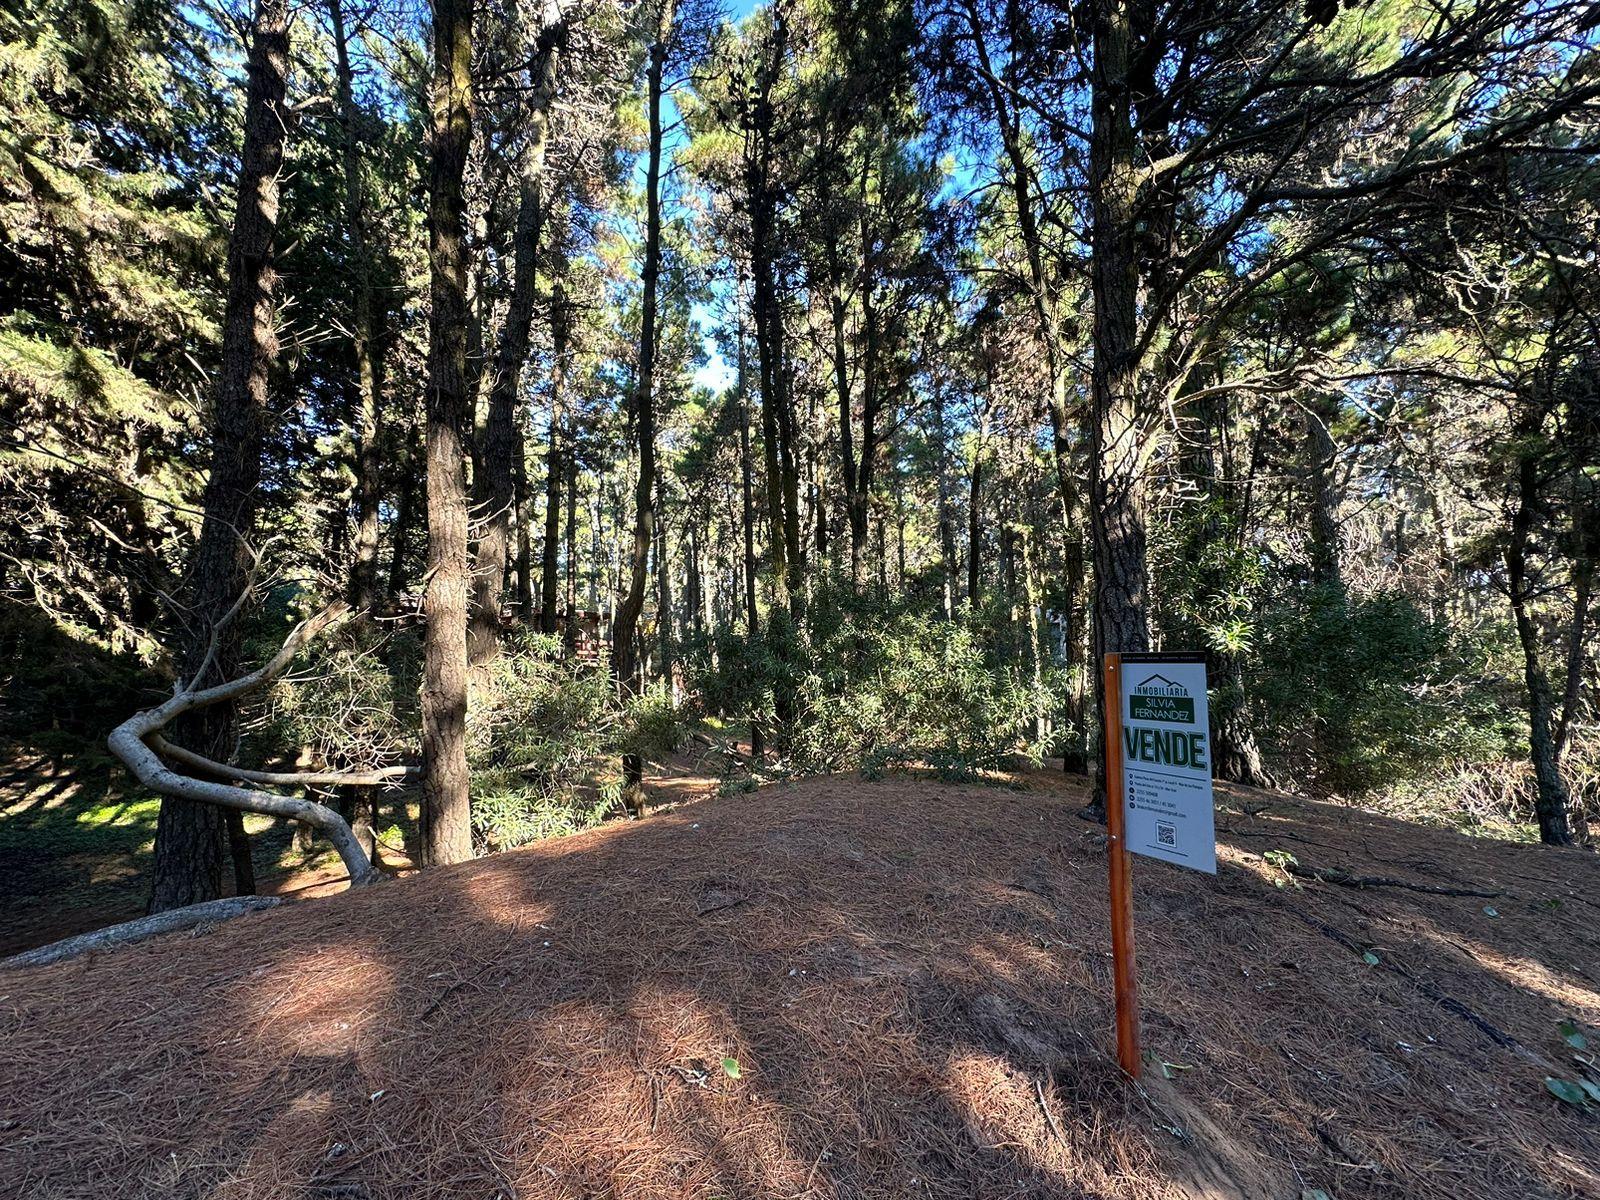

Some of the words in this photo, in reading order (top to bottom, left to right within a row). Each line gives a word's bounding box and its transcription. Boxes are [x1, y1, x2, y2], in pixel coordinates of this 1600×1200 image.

[1134, 686, 1189, 697] INMOBILIARIA
[1146, 697, 1176, 708] SILVIA
[1135, 708, 1189, 721] FERNANDEZ
[1123, 727, 1208, 771] VENDE
